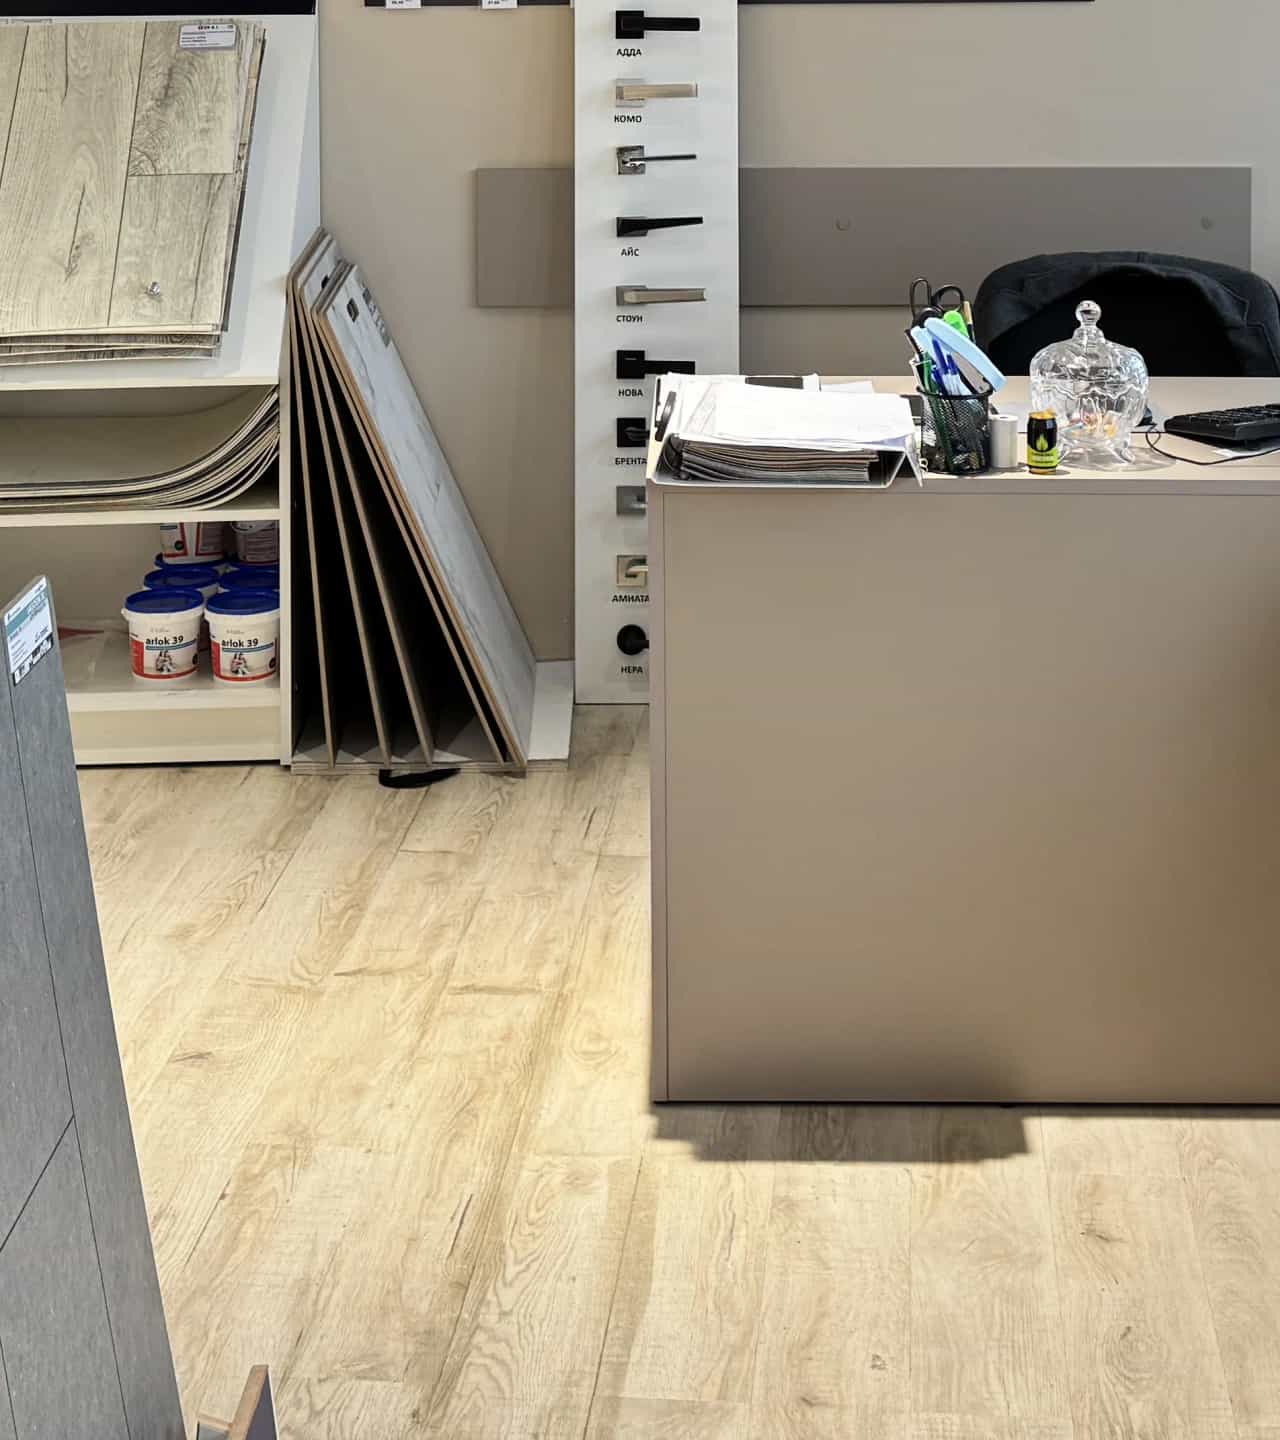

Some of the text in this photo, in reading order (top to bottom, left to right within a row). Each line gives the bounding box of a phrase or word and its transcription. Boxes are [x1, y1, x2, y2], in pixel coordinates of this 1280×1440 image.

[615, 47, 642, 58] АДДА
[613, 114, 643, 124] КОМО
[620, 247, 640, 257] АЙС
[616, 314, 643, 324] СТОУН
[618, 388, 644, 398] НОВА
[615, 456, 648, 466] БРЕНТА
[171, 635, 184, 645] 39
[247, 638, 259, 647] 39
[621, 665, 644, 674] НЕРА
